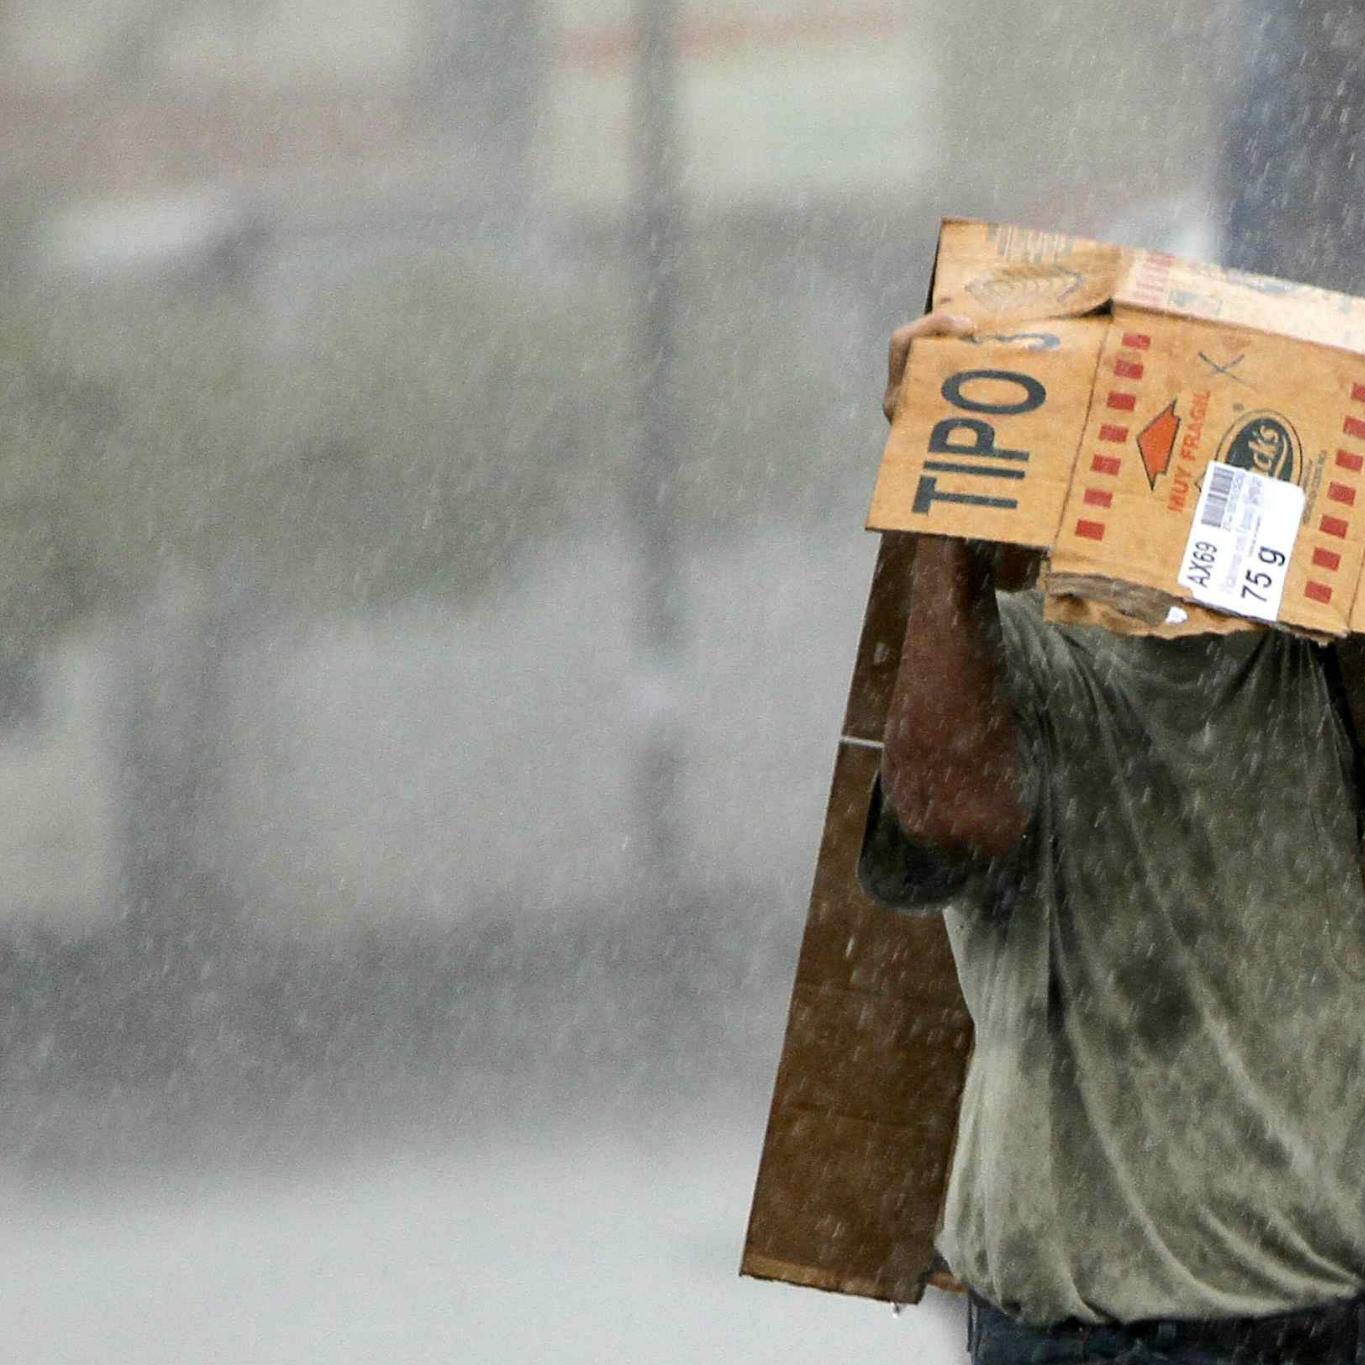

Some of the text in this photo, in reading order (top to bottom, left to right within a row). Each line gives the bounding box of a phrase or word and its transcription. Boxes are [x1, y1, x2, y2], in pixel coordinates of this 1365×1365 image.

[912, 370, 1046, 514] TIPO
[1167, 391, 1210, 512] MUY FRAGIL
[1187, 541, 1217, 588] AX69
[1241, 570, 1272, 602] 75
[1258, 546, 1286, 567] g
